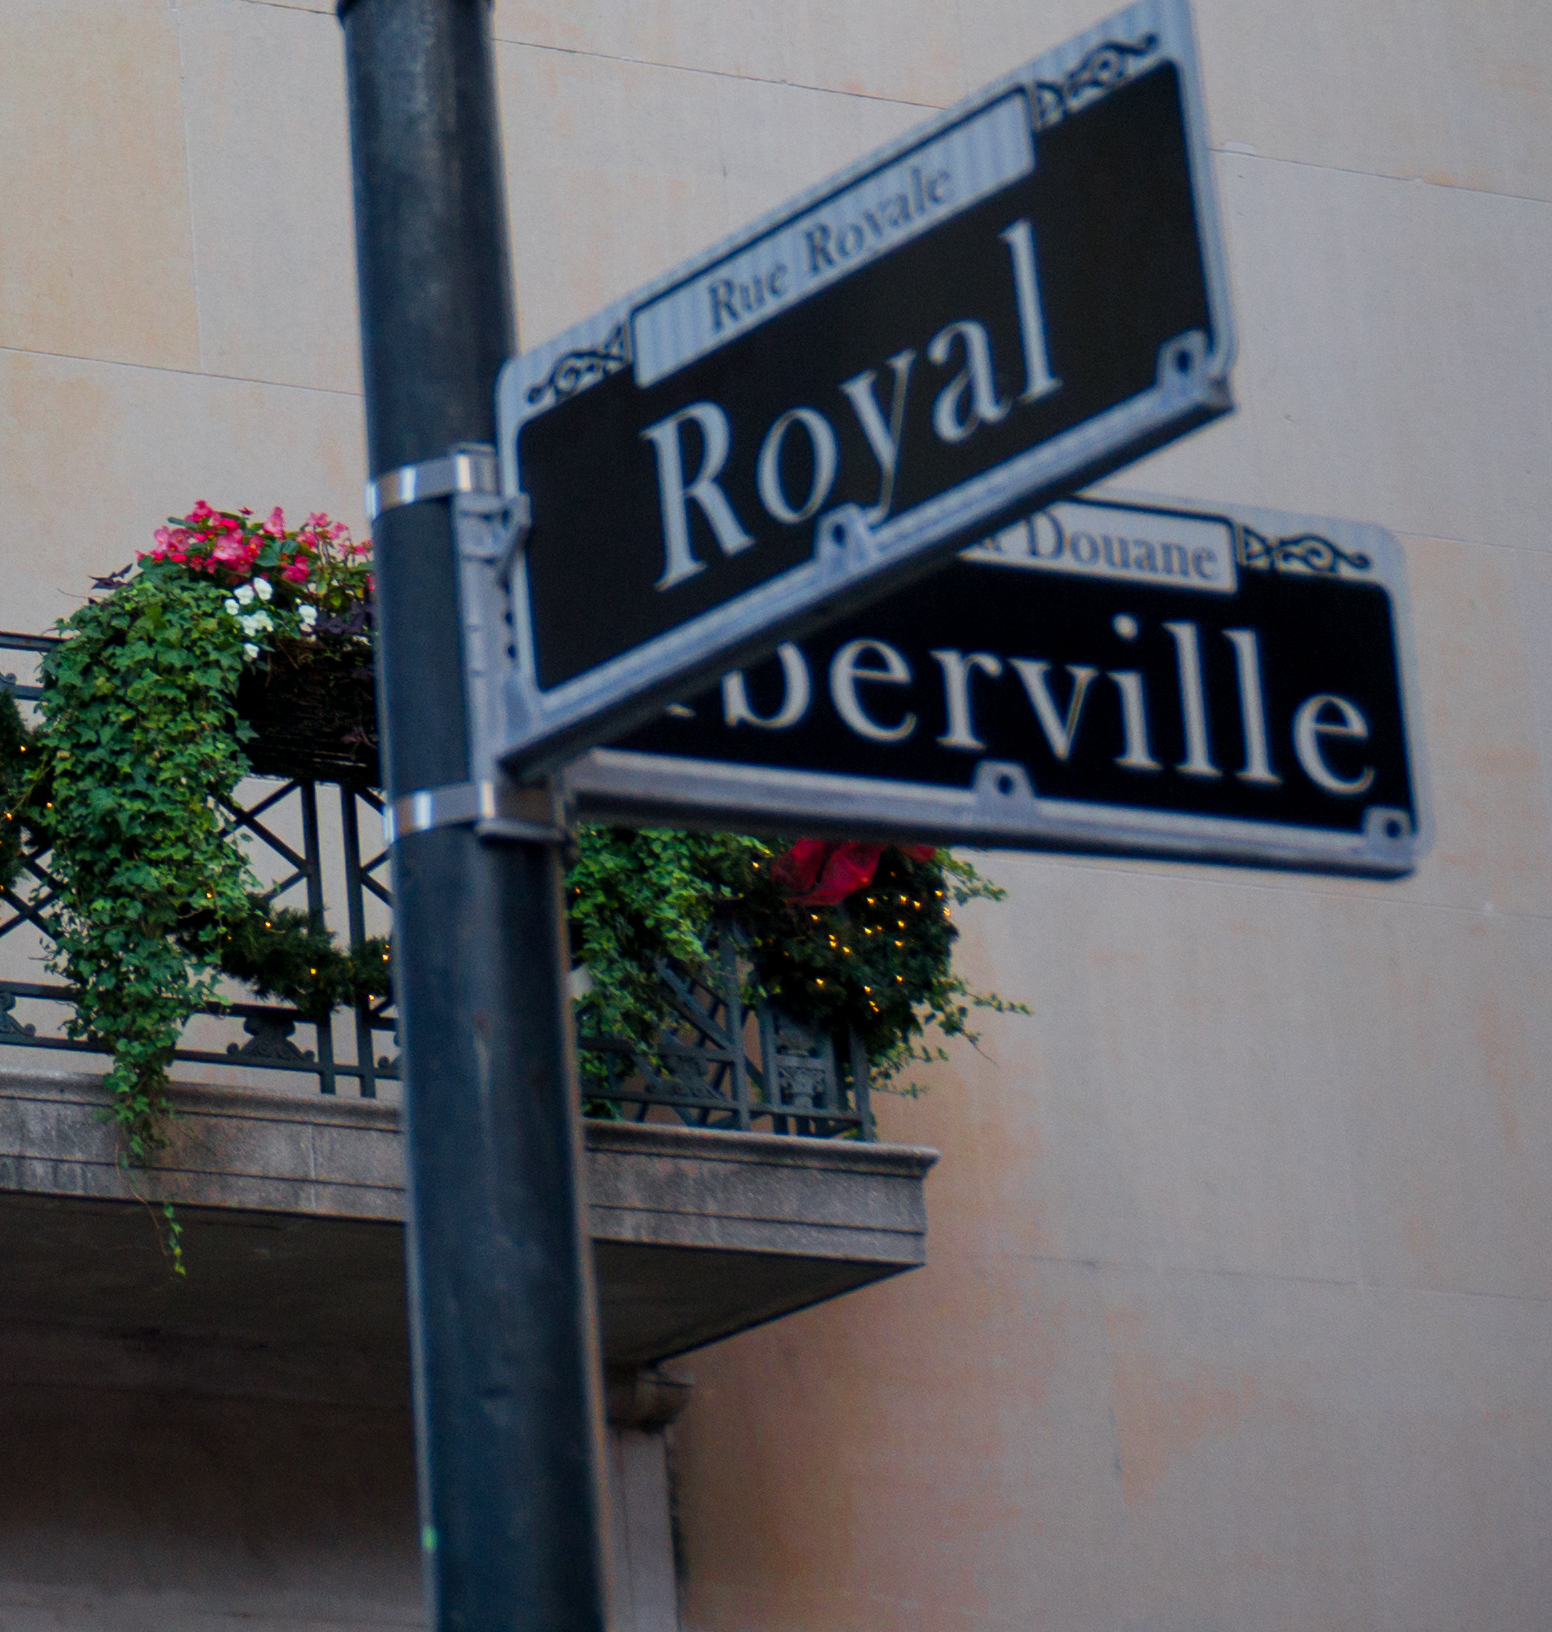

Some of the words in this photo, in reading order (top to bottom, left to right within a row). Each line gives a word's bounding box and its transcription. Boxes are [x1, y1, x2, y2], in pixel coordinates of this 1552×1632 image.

[707, 262, 788, 334] Rue
[803, 165, 953, 273] Royale
[639, 218, 1064, 593] Royal
[1024, 508, 1217, 580] Douane
[665, 612, 1377, 796] berville
